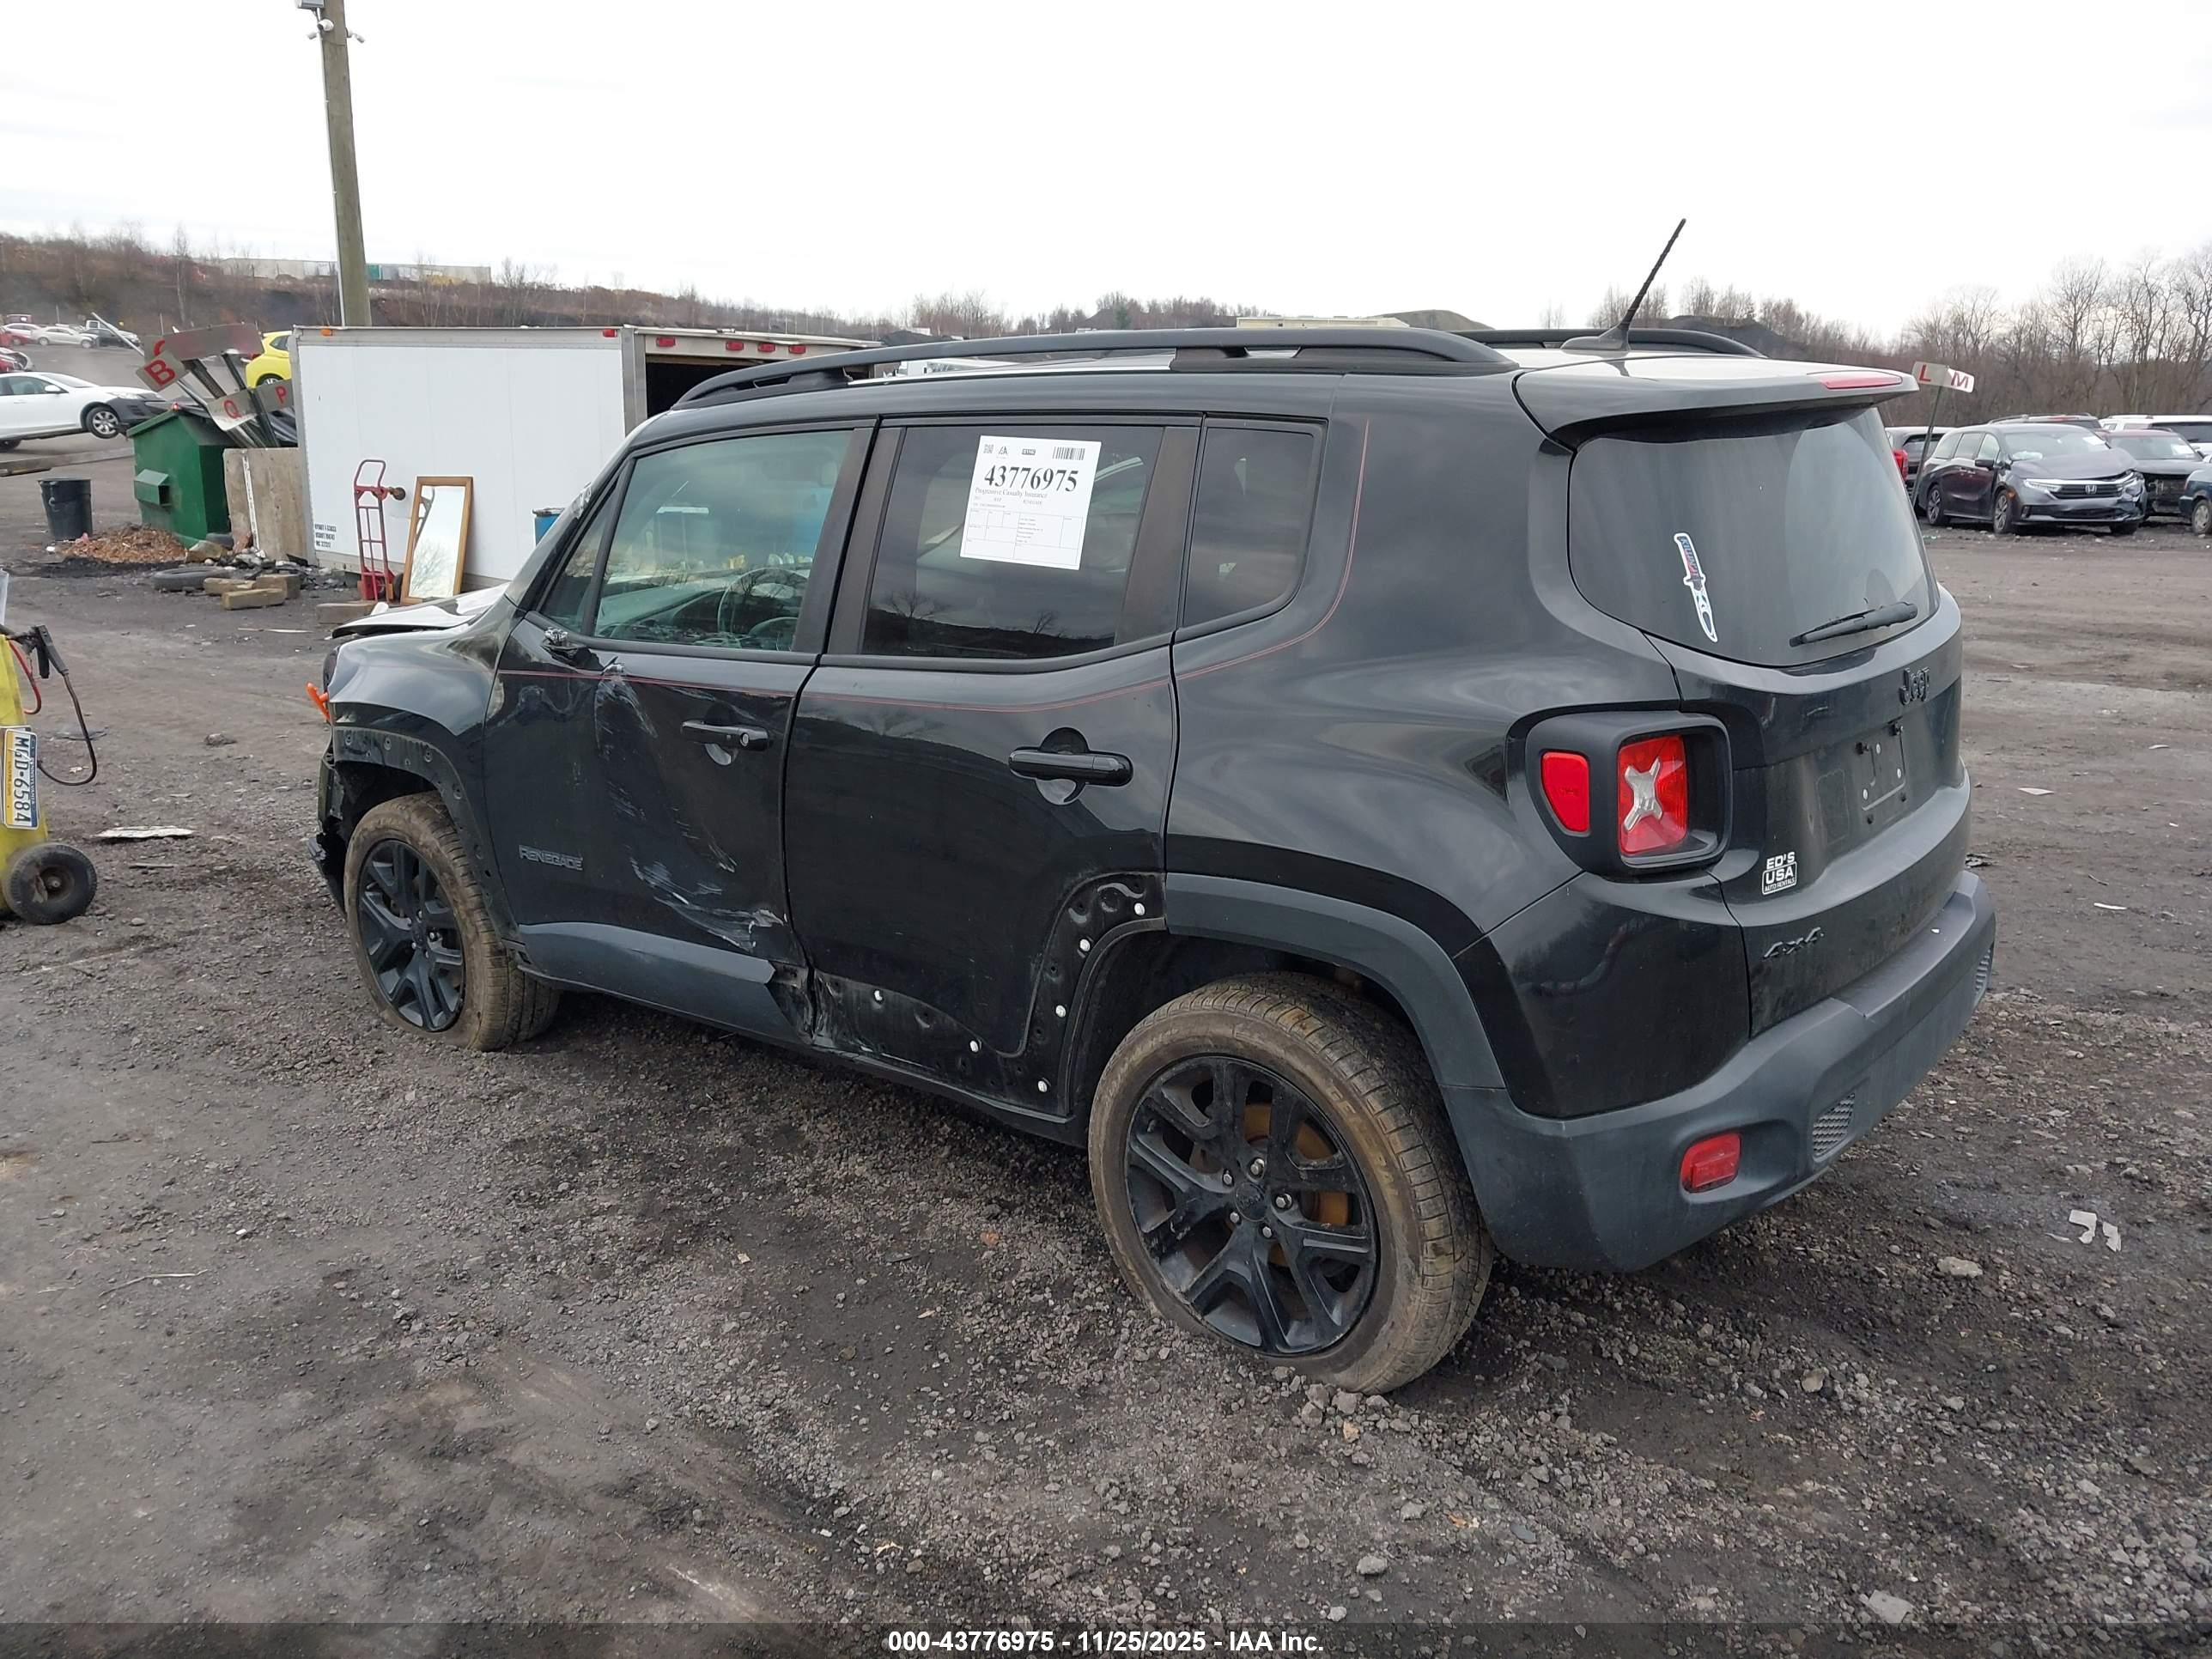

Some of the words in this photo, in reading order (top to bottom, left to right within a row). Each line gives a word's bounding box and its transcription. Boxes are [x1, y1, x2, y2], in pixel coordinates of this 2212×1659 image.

[144, 360, 176, 385] B
[1919, 364, 1931, 382] L
[1951, 372, 1969, 389] M
[275, 386, 287, 404] P
[223, 399, 241, 419] Q
[984, 465, 1079, 492] 43776975
[1899, 667, 1929, 705] Jeep
[14, 737, 32, 823] MGD-6584
[519, 845, 584, 871] RENEGADE
[1766, 852, 1796, 870] ED'S
[1765, 866, 1794, 884] USA
